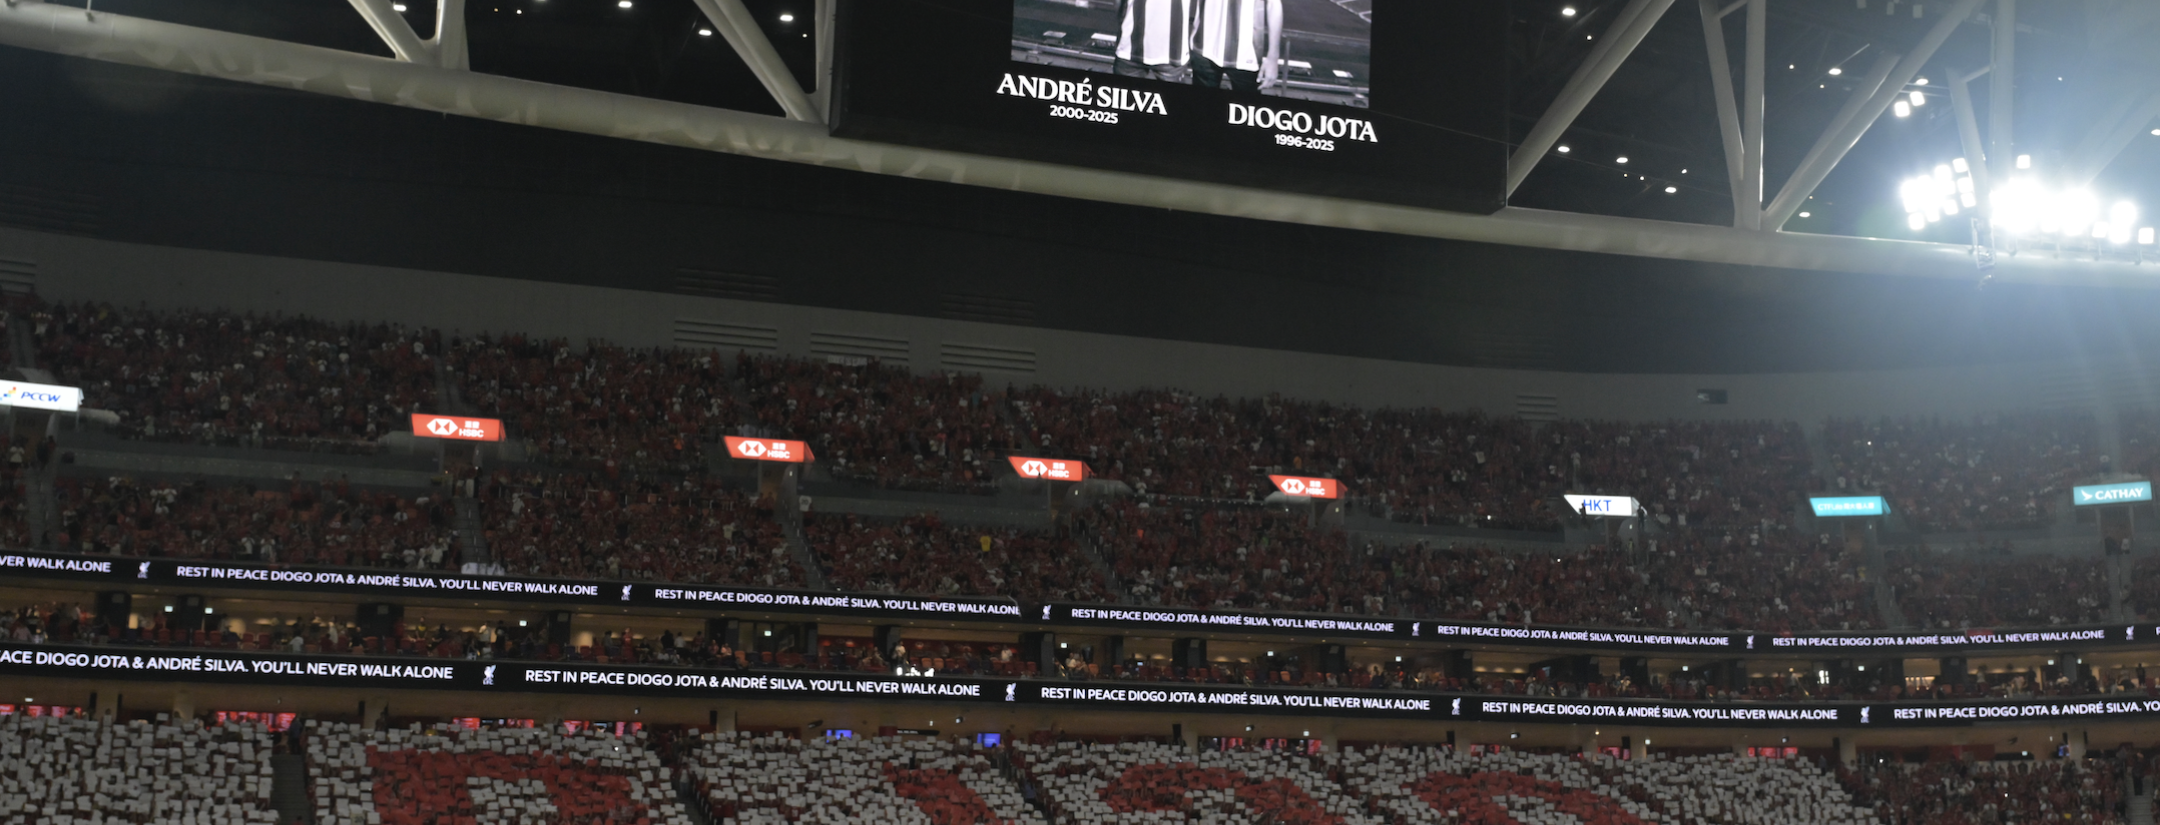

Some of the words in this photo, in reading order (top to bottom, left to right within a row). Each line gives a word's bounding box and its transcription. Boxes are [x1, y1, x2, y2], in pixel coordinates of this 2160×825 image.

[996, 73, 1093, 105] ANDRÉ
[1097, 86, 1168, 115] SILVA
[1049, 105, 1118, 124] 2000-2025
[1228, 102, 1312, 134] DIOGO
[1314, 115, 1379, 142] JOTA
[1274, 133, 1335, 152] 1996-2025
[21, 391, 61, 403] PCCW
[459, 428, 484, 438] HSBC
[767, 450, 790, 459] HSBC
[2095, 487, 2144, 500] CATHAY
[1583, 499, 1612, 512] HKT
[27, 556, 64, 570] WALK
[66, 559, 111, 573] ALONE
[177, 565, 209, 578] REST
[211, 567, 224, 579] IN
[227, 568, 268, 581] PEACE
[271, 570, 313, 583] DIOGO
[314, 572, 344, 584] JOTA
[346, 573, 355, 585] &
[357, 574, 400, 587] ANDRÉ
[403, 576, 437, 589] SILVA.
[483, 580, 522, 592] NEVER
[525, 582, 557, 594] WALK
[559, 584, 598, 596] ALONE
[655, 588, 683, 600] REST
[685, 590, 696, 601] IN
[699, 590, 734, 602] PEACE
[737, 592, 773, 604] DIOGO
[775, 594, 800, 605] JOTA
[802, 595, 810, 606] &
[812, 594, 849, 608] ANDRÉ
[851, 597, 881, 609] SILVA.
[921, 601, 956, 612] NEVER
[957, 603, 986, 614] WALK
[1072, 608, 1096, 619] REST
[1098, 609, 1108, 619] IN
[1110, 609, 1141, 621] PEACE
[1143, 611, 1175, 623] DIOGO
[1176, 613, 1199, 623] JOTA
[1200, 614, 1208, 624] &
[1209, 614, 1242, 626] ANDRÉ
[1243, 616, 1270, 627] SILVA.
[1305, 619, 1336, 630] NEVER
[1337, 620, 1362, 631] WALK
[1364, 621, 1394, 633] ALONE
[1438, 625, 1459, 635] REST
[1461, 626, 1470, 636] IN
[1472, 626, 1499, 637] PEACE
[1501, 628, 1529, 639] DIOGO
[1531, 629, 1551, 639] JOTA
[1552, 630, 1558, 640] &
[1559, 630, 1588, 642] ANDRÉ
[1590, 632, 1613, 642] SILVA.
[1644, 634, 1672, 645] NEVER
[1673, 636, 1698, 646] WALK
[1699, 636, 1729, 646] ALONE
[1773, 637, 1796, 647] REST
[1797, 637, 1807, 647] IN
[1809, 637, 1838, 647] PEACE
[1840, 637, 1871, 647] DIOGO
[1873, 636, 1895, 646] JOTA
[1897, 636, 1904, 646] &
[1906, 634, 1939, 646] ANDRÉ
[1940, 635, 1968, 645] SILVA.
[2006, 632, 2039, 643] NEVER
[2040, 631, 2069, 642] WALK
[2070, 629, 2104, 640] ALONE
[0, 649, 33, 665] ACE
[36, 651, 89, 667] DIOGO
[91, 654, 130, 669] JOTA
[132, 656, 144, 670] &
[146, 655, 201, 671] ANDRÉ
[205, 658, 248, 673] SILVA.
[252, 660, 304, 675] YOU'LL
[307, 662, 357, 676] NEVER
[360, 664, 401, 678] WALK
[403, 665, 453, 680] ALONE
[526, 669, 561, 683] REST
[563, 670, 577, 683] IN
[580, 671, 624, 685] PEACE
[628, 672, 672, 687] DIOGO
[675, 674, 707, 688] JOTA
[709, 675, 719, 688] &
[721, 674, 767, 690] ANDRÉ
[770, 677, 807, 691] SILVA.
[810, 679, 854, 693] YOU'LL
[856, 680, 899, 694] NEVER
[901, 682, 936, 695] WALK
[938, 683, 980, 697] ALONE
[1042, 686, 1071, 699] REST
[1073, 688, 1085, 700] IN
[1088, 688, 1126, 701] PEACE
[1128, 689, 1167, 703] DIOGO
[1168, 691, 1196, 703] JOTA
[1198, 692, 1206, 704] &
[1208, 691, 1248, 705] ANDRÉ
[1250, 693, 1282, 706] SILVA.
[1284, 695, 1322, 708] YOU'LL
[1324, 696, 1360, 709] NEVER
[1362, 697, 1392, 710] WALK
[1394, 698, 1430, 711] ALONE
[1483, 701, 1508, 713] REST
[1510, 702, 1521, 714] IN
[1523, 702, 1555, 715] PEACE
[1557, 703, 1591, 716] DIOGO
[1592, 705, 1616, 717] JOTA
[1617, 705, 1625, 717] &
[1626, 705, 1661, 718] ANDRÉ
[1662, 707, 1691, 719] SILVA.
[1692, 708, 1729, 720] YOU'LL
[1731, 708, 1766, 720] NEVER
[1767, 709, 1798, 720] WALK
[1800, 708, 1837, 720] ALONE
[1894, 708, 1923, 720] REST
[1925, 708, 1937, 719] IN
[1939, 706, 1976, 719] PEACE
[1979, 705, 2018, 718] DIOGO
[2020, 704, 2049, 717] JOTA
[2051, 704, 2059, 716] &
[2062, 700, 2104, 715] ANDRÉ
[2106, 701, 2142, 714] SILVA.
